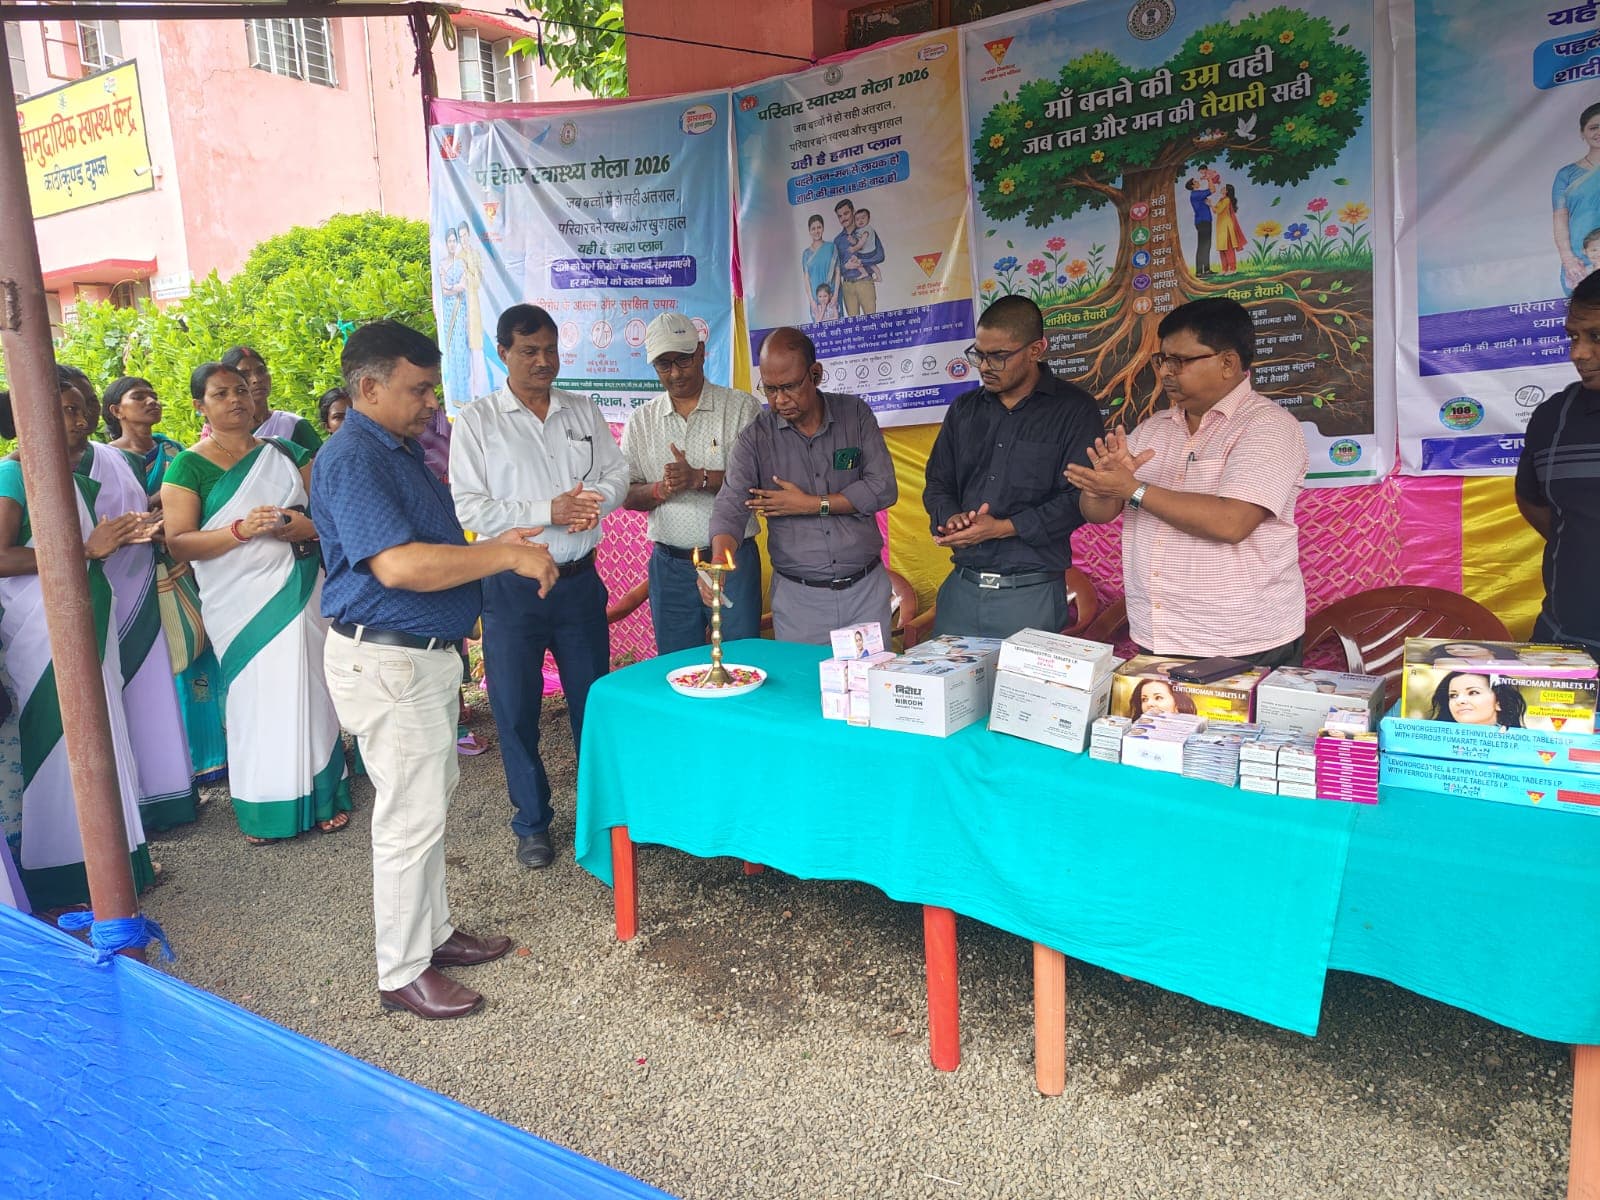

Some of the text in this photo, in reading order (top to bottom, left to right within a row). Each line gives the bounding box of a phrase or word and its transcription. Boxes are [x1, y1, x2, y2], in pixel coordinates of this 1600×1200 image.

[1044, 44, 1274, 120] माँ बनने की उम्र वही
[757, 67, 930, 121] परिवार स्वास्थ्य मेला 2026
[793, 123, 806, 134] जब
[844, 106, 860, 120] सही
[1023, 72, 1313, 155] जब तन और मन की तैयारी सही
[77, 104, 113, 145] स्वास्थ्य
[789, 138, 816, 152] परिवार
[850, 124, 867, 137] और
[867, 116, 903, 135] खुशहाल
[791, 135, 902, 170] यही है हमारा प्लान
[85, 155, 109, 190] दुमका
[591, 155, 629, 180] मेला
[634, 154, 670, 176] 2026
[795, 174, 813, 187] पहले
[851, 165, 859, 176] से
[860, 159, 887, 172] लायक
[890, 154, 899, 166] हो
[816, 187, 827, 198] की
[829, 184, 845, 196] बात
[859, 178, 867, 188] के
[869, 175, 885, 186] बाद
[888, 171, 897, 182] हो
[566, 197, 581, 208] जब
[624, 188, 640, 207] सही
[559, 220, 588, 235] परिवार
[603, 221, 629, 233] स्वस्थ
[630, 215, 648, 232] और
[648, 216, 687, 236] खुशहाल
[577, 241, 597, 255] यही
[638, 240, 664, 252] प्लान
[1255, 284, 1284, 298] तैयारी
[1046, 307, 1107, 326] शारीरिक तैयारी
[1509, 301, 1556, 314] परिवार
[1533, 317, 1566, 328] ध्यान
[1476, 341, 1488, 350] की
[1494, 337, 1517, 349] शादी
[1522, 337, 1532, 346] 18
[1538, 335, 1560, 344] साल
[1256, 373, 1289, 385] और तैयारी
[895, 388, 940, 400] झारखण्ड
[1453, 406, 1472, 415] 108
[1173, 685, 1215, 697] CENTCHROMAN
[1215, 690, 1237, 699] TABLETS
[1552, 681, 1583, 690] TABLETS
[895, 698, 923, 706] NIRODH
[1395, 723, 1453, 735] LEVONORGESTREL
[1461, 729, 1530, 743] ETHINYLOESTRADIOL
[1532, 735, 1564, 745] TABLETS
[1412, 733, 1441, 742] FERROUS
[1442, 736, 1477, 746] FUMARATE
[1480, 740, 1508, 749] TABLETS
[1388, 759, 1444, 772] LEVONORGESTREL
[1452, 768, 1520, 782] ETHINYLOESTRADIOL
[1522, 776, 1552, 786] TABLETS
[1404, 769, 1432, 779] FERROUS
[1434, 774, 1468, 784] FUMARATE
[1470, 778, 1499, 788] TABLETS
